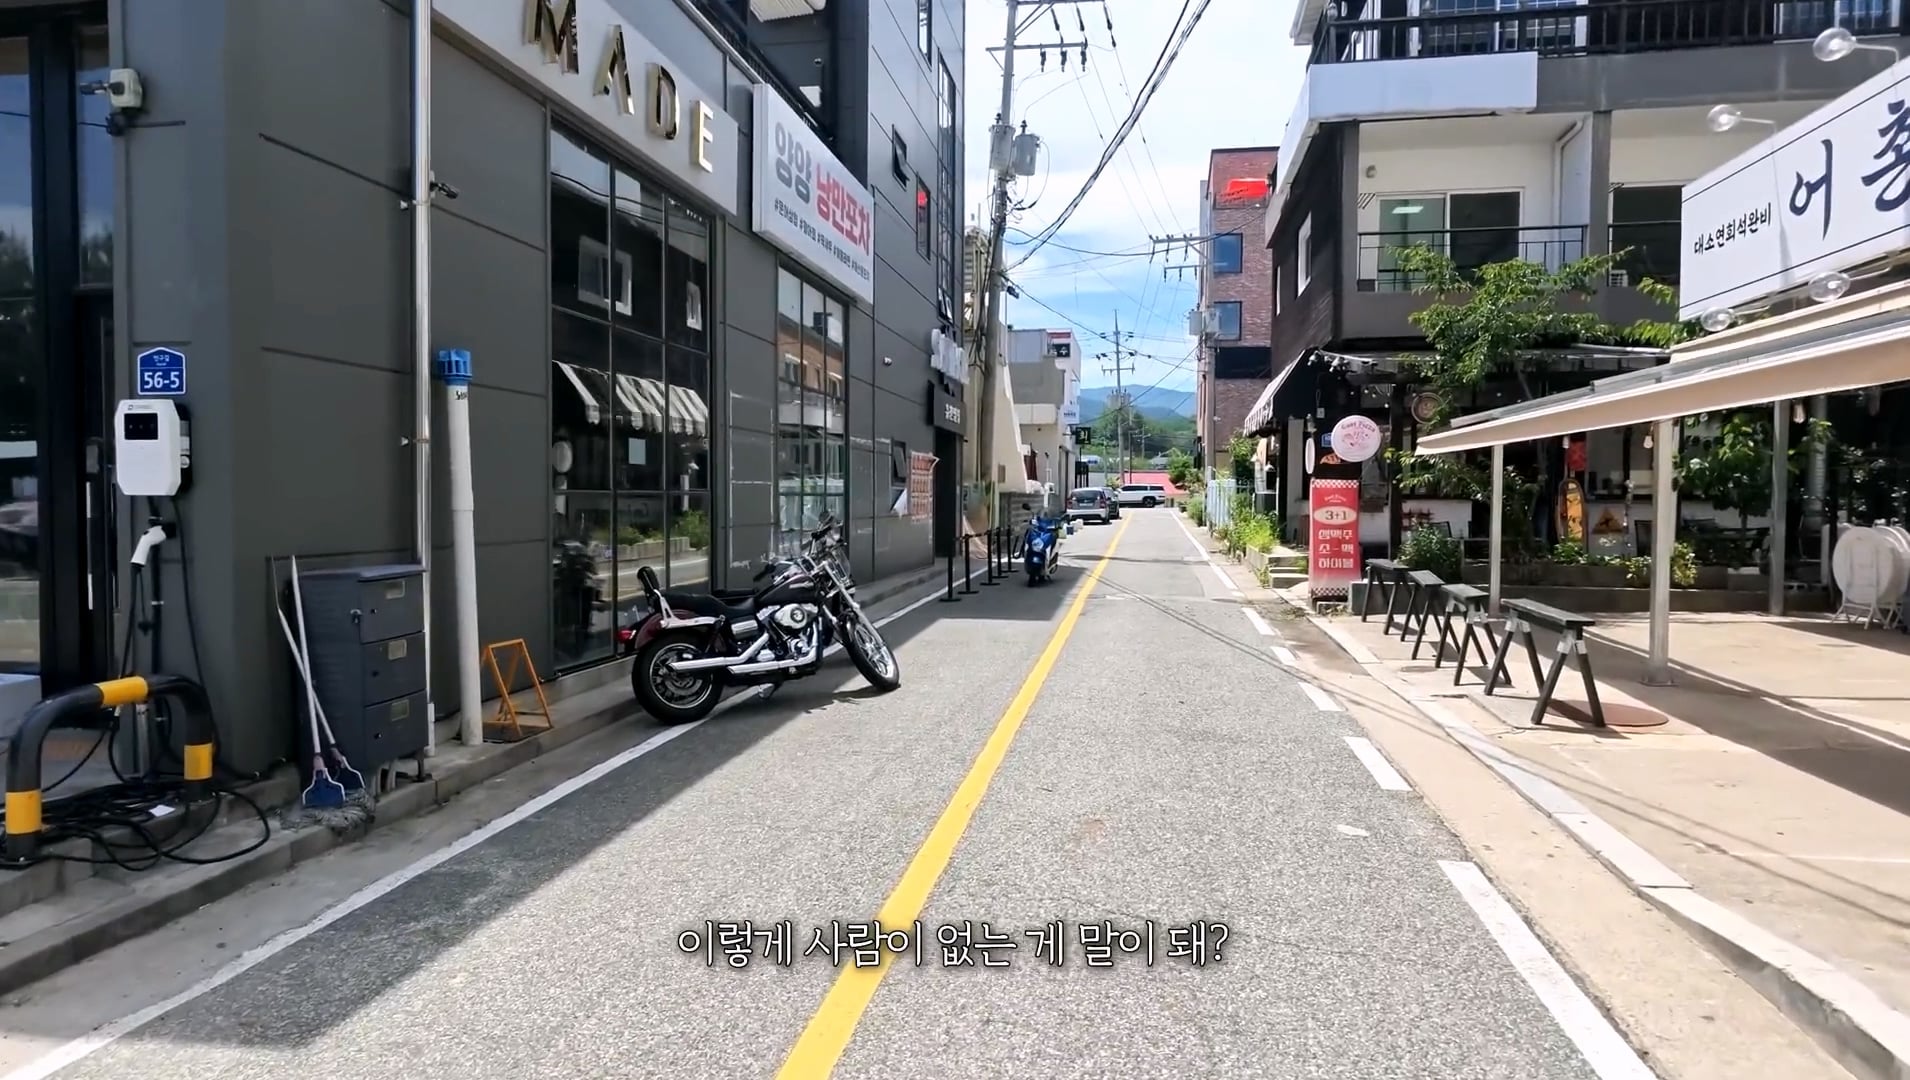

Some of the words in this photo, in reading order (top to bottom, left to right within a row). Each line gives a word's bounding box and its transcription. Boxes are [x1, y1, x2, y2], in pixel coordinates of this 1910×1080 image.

[523, 0, 714, 173] MADE
[774, 121, 813, 205] 양양
[815, 162, 872, 256] 낭만포차
[1693, 201, 1772, 255] 대소연회석완비
[143, 371, 180, 389] 56-5
[1324, 509, 1348, 521] 3+1
[1318, 529, 1353, 540] 생맥주
[1318, 557, 1354, 569] 하이볼
